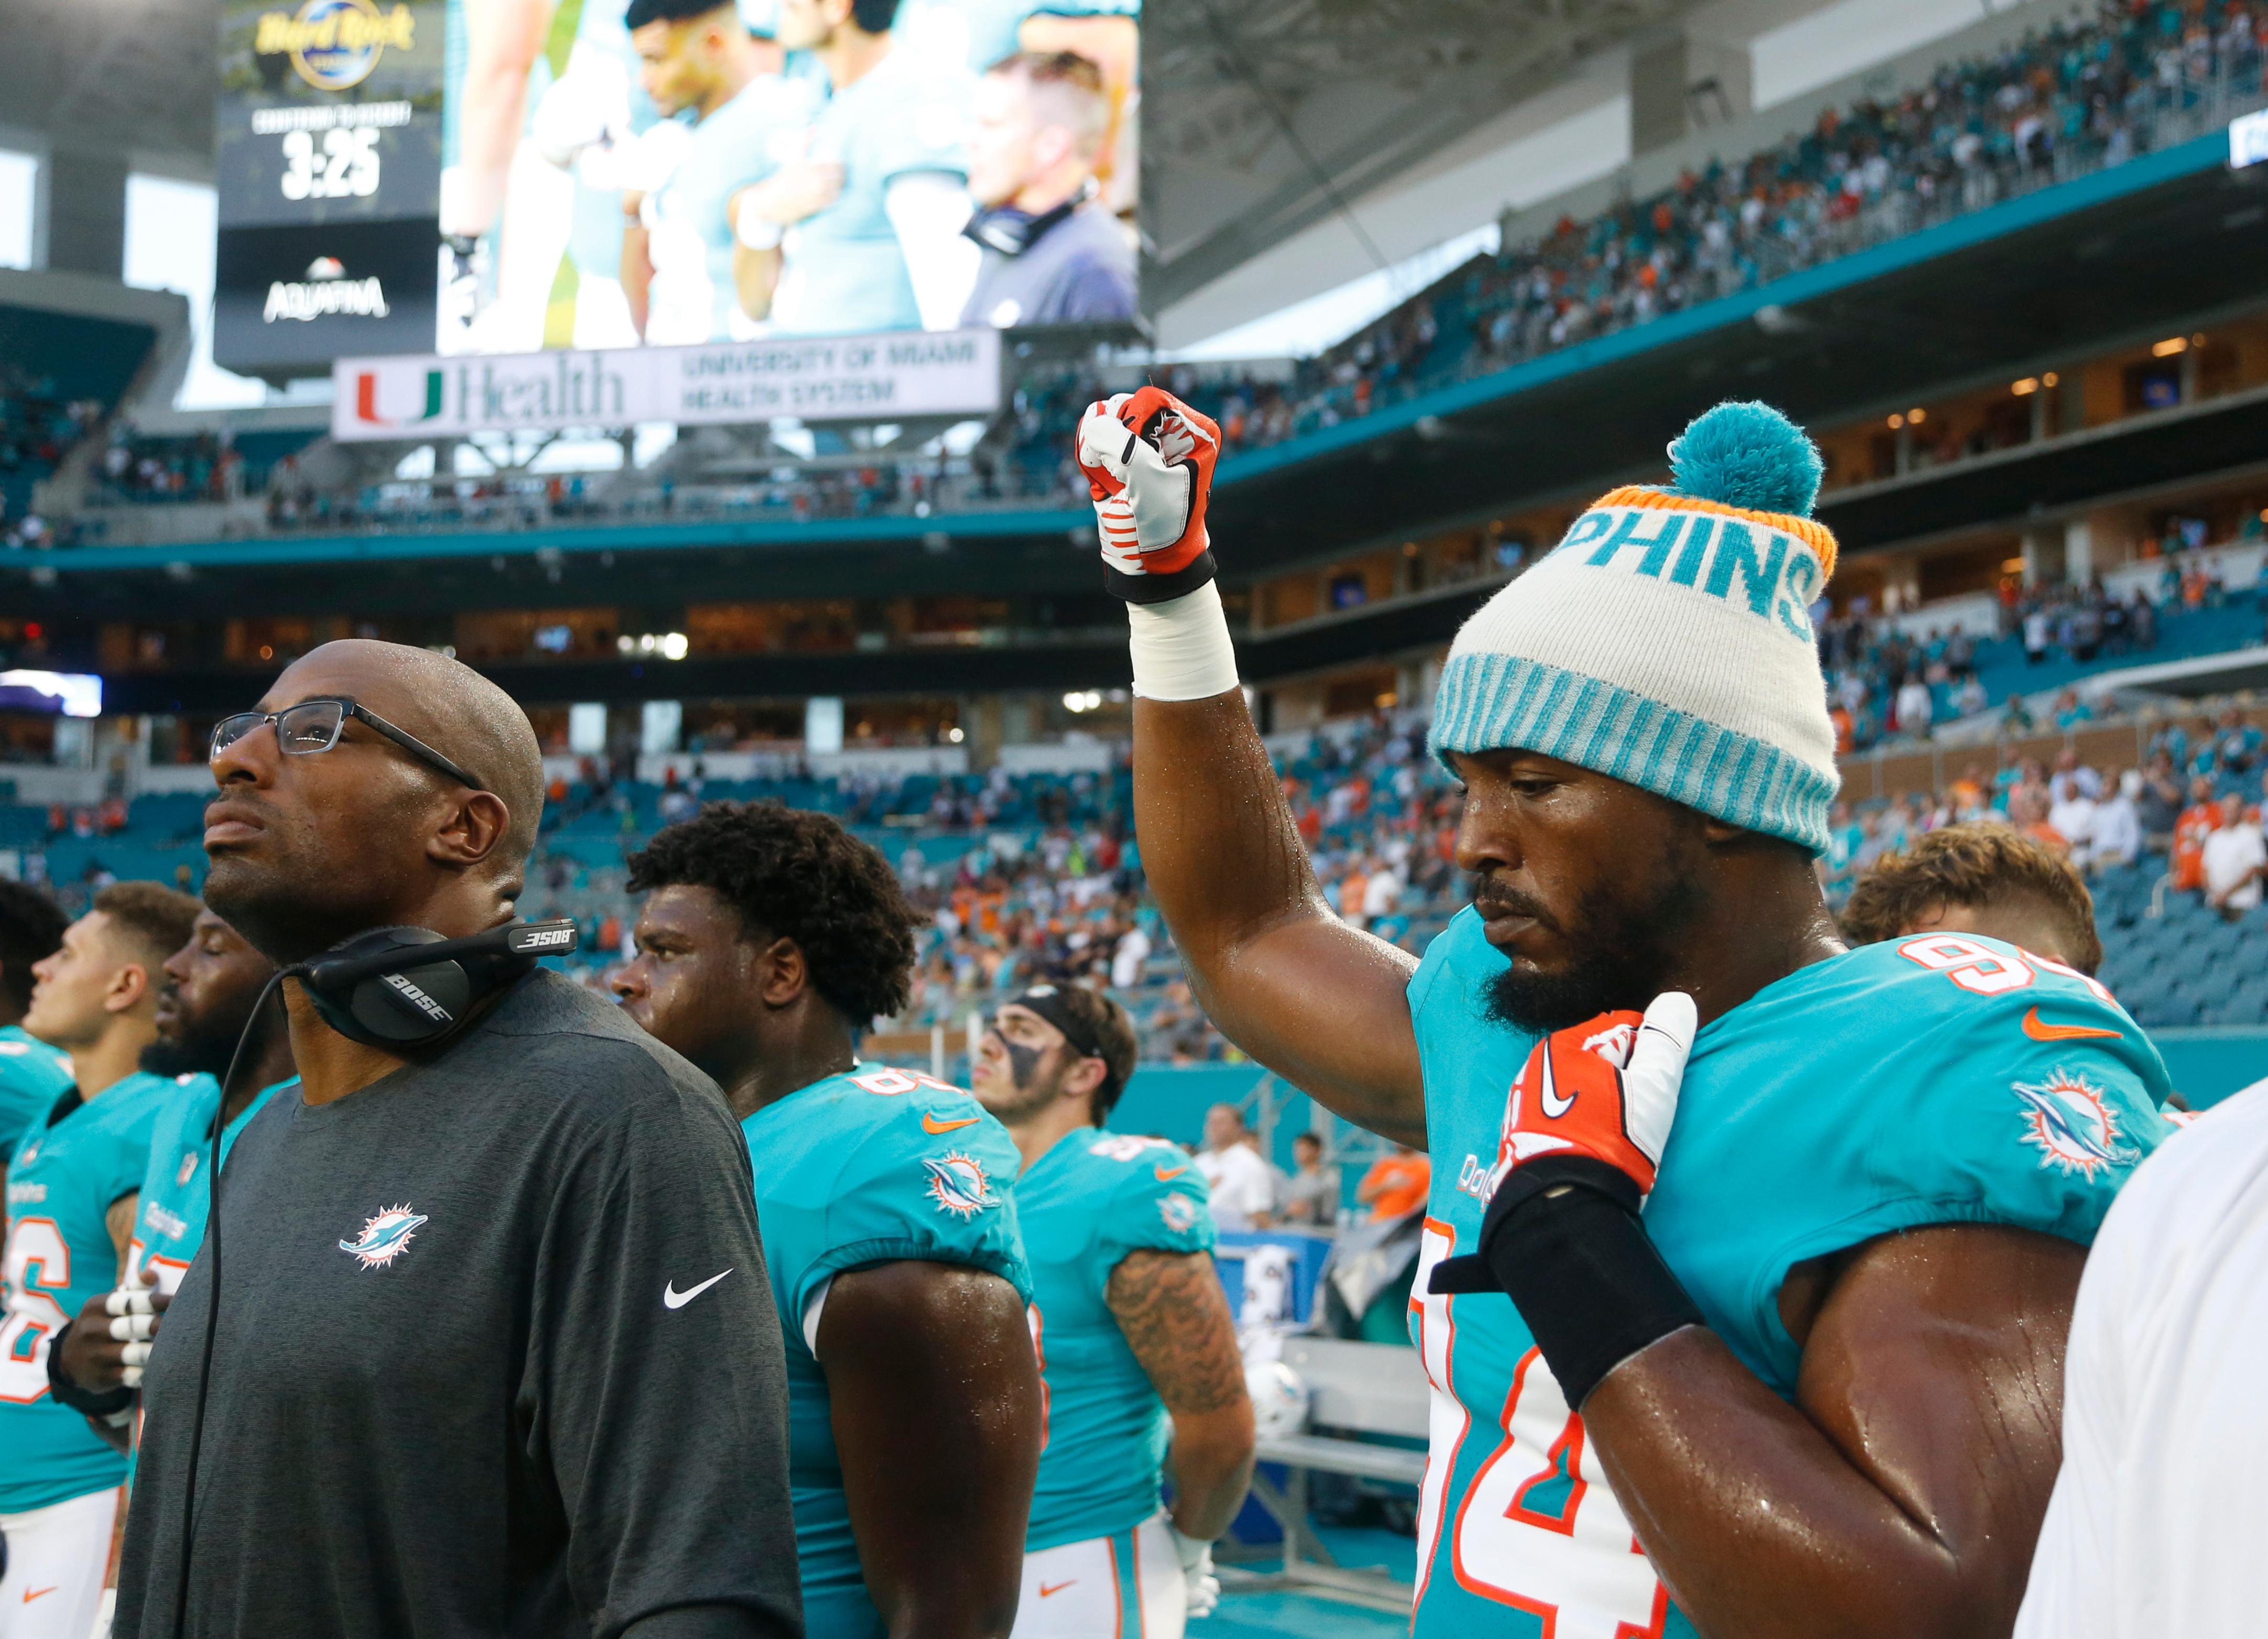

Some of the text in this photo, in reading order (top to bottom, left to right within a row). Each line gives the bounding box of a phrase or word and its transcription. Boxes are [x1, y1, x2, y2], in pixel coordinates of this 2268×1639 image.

[281, 126, 381, 200] 3:25
[263, 276, 391, 323] AQUAFINA
[682, 337, 976, 376] UNIVERSITY OF MIAMI
[683, 378, 896, 410] HEALTH SYSTEM
[1550, 511, 1814, 643] PHINS
[517, 928, 575, 948] BOSE
[380, 973, 453, 1022] BOSE
